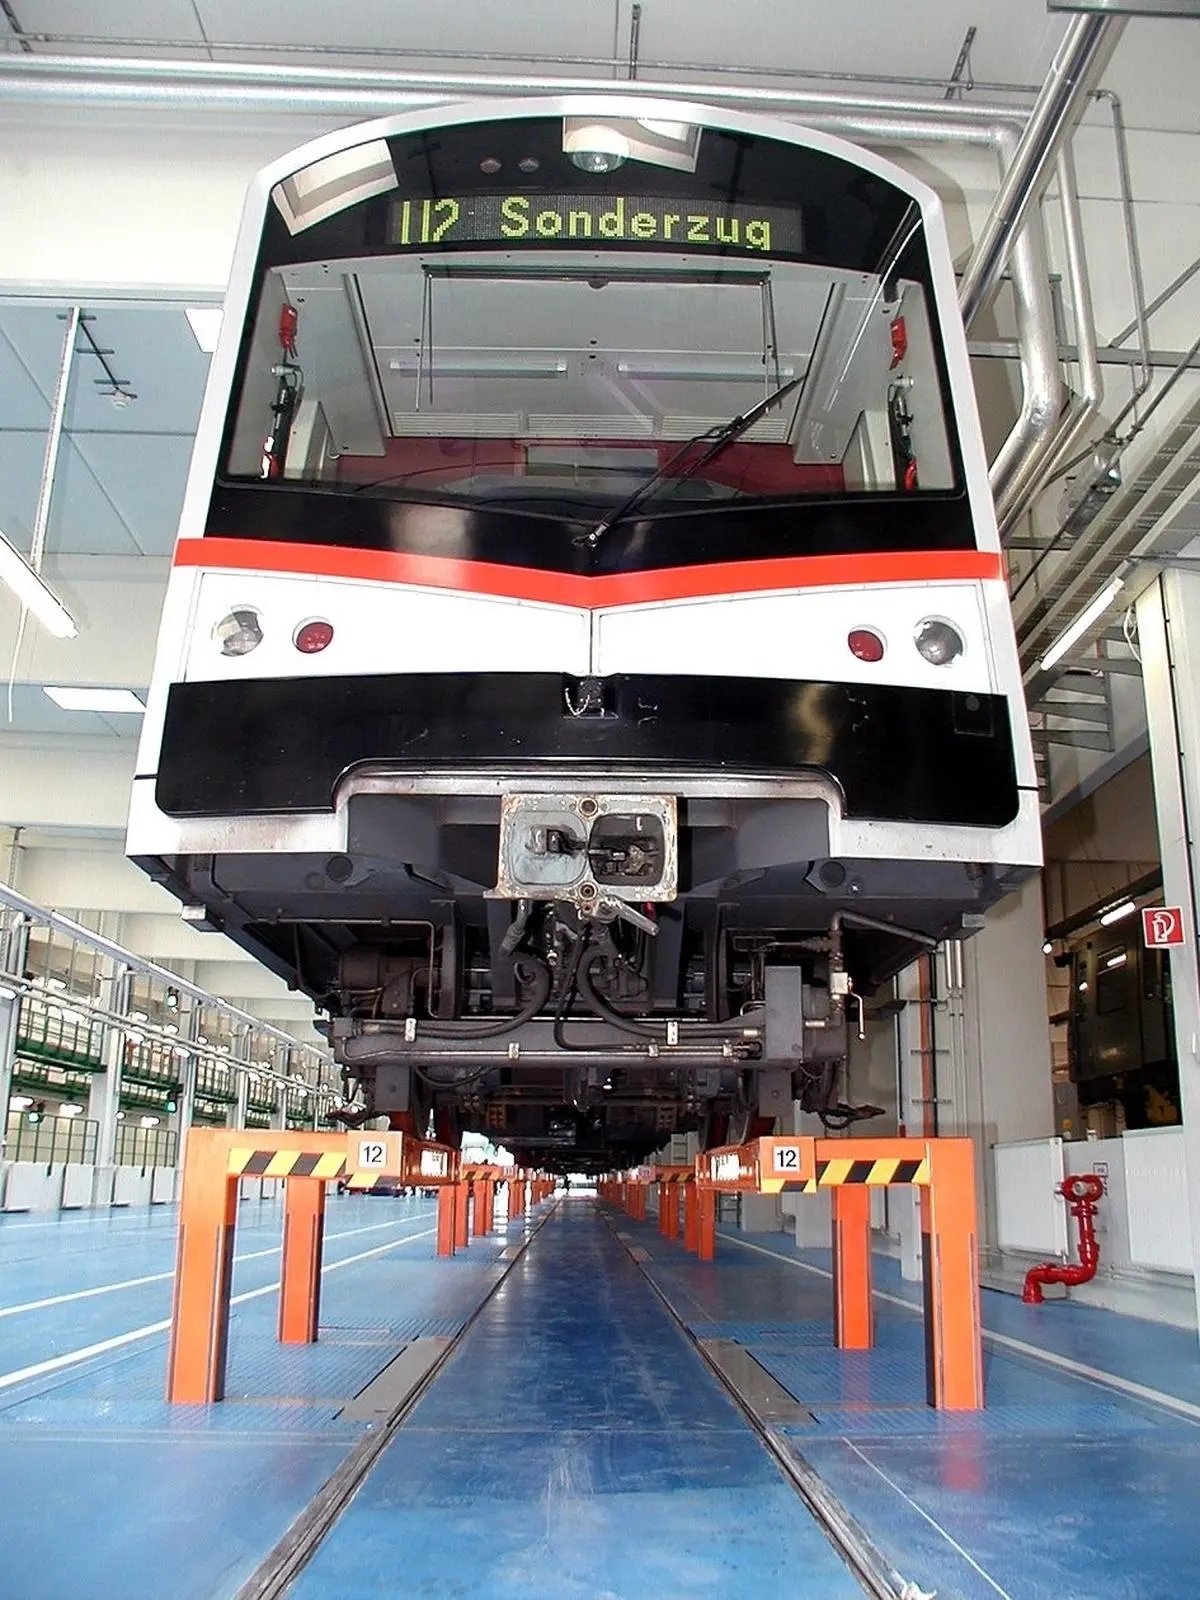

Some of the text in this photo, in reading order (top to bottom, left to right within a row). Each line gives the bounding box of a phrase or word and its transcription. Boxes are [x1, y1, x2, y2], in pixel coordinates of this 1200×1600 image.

[501, 197, 770, 250] Sonderzug
[364, 1145, 383, 1163] 12
[777, 1149, 797, 1168] 12
